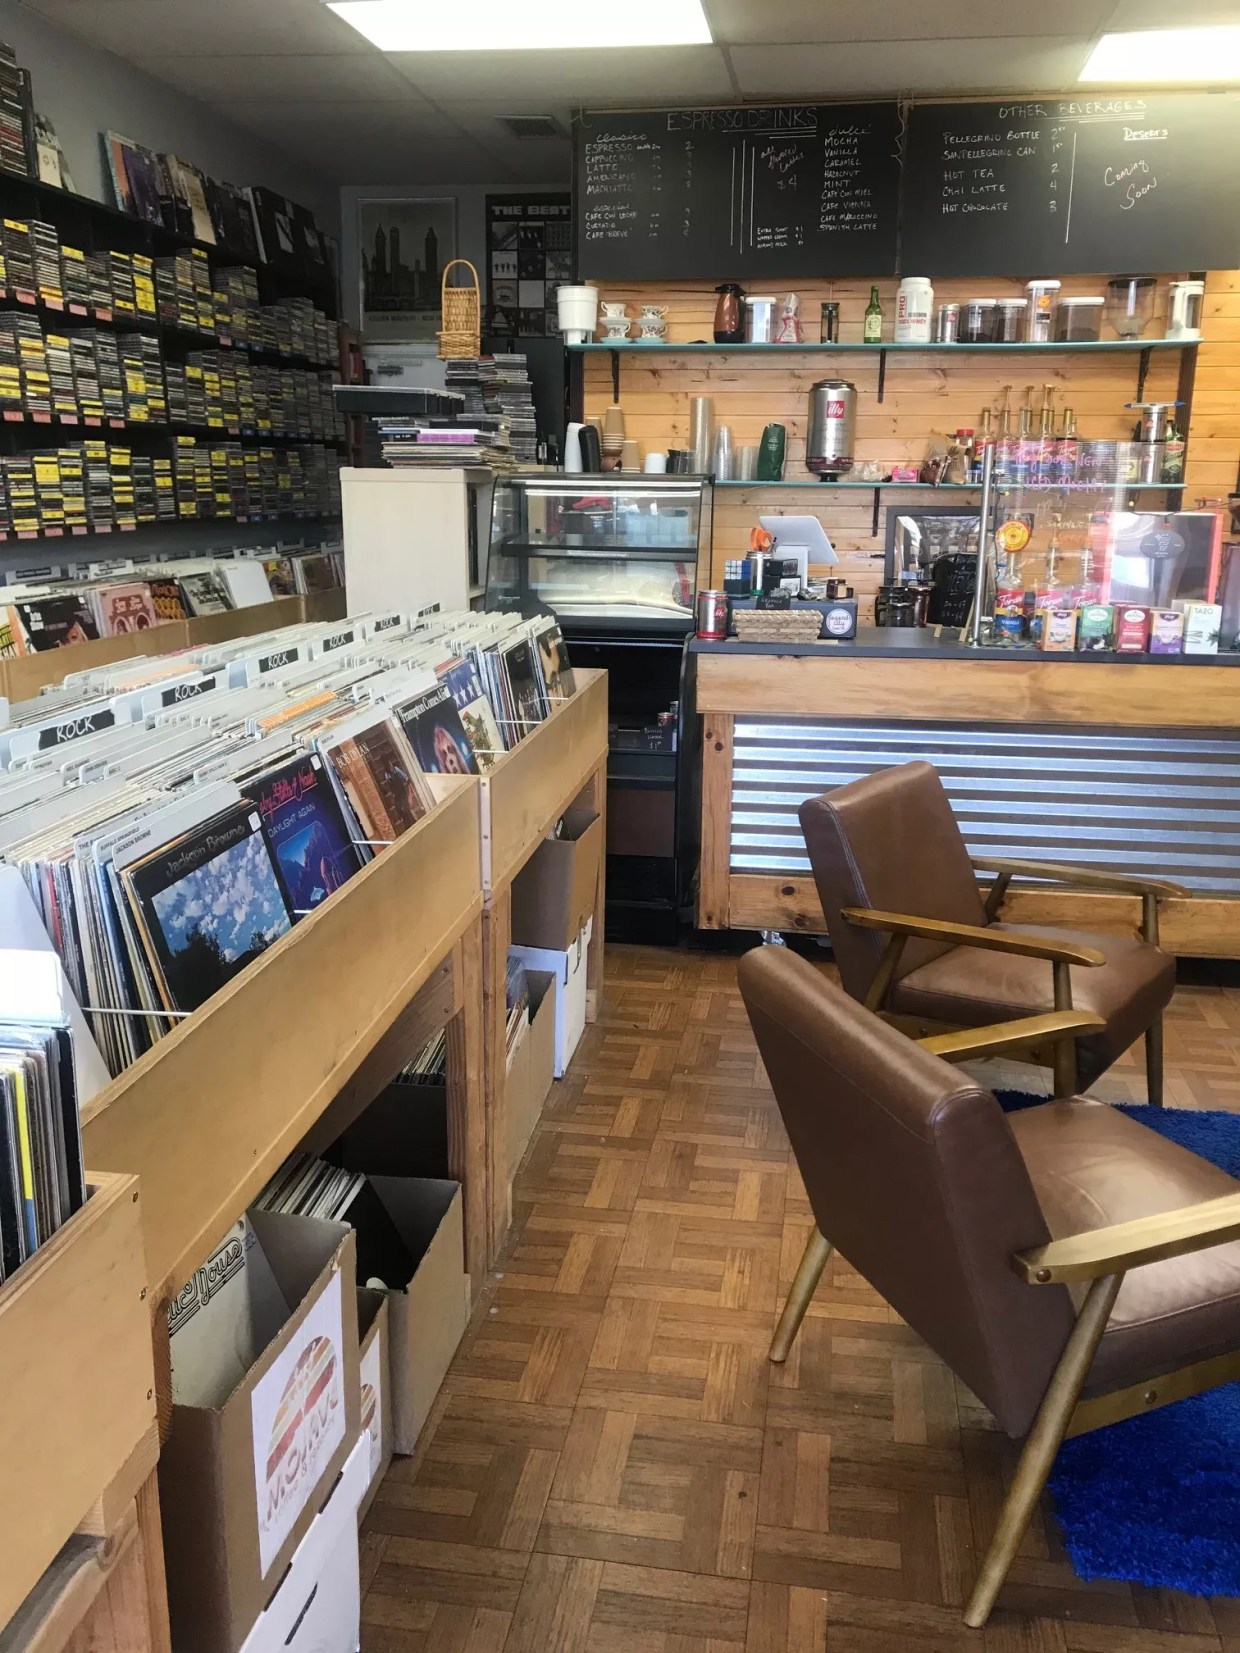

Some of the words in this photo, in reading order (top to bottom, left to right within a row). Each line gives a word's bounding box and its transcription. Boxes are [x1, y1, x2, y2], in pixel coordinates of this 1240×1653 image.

[999, 104, 1047, 119] OTHER
[1059, 100, 1147, 115] BEVERAGES
[667, 110, 743, 130] ESPRESSO
[747, 107, 817, 128] DRINKS
[824, 136, 858, 147] MOCHA
[942, 131, 1001, 144] PELLEGRINO
[1006, 130, 1040, 141] BOTTLE
[585, 143, 633, 154] ESPRESSO
[824, 147, 858, 158] VANILLA
[1016, 146, 1037, 157] CAN
[586, 164, 618, 174] LATTE
[824, 158, 862, 168] CARAMEL
[943, 170, 965, 181] HOT
[972, 168, 994, 179] TEA
[1051, 162, 1060, 173] 2
[1104, 160, 1150, 186] Coming
[824, 179, 851, 189] MINT
[942, 186, 964, 197] CHAI
[971, 183, 1006, 194] LATTE
[1049, 179, 1057, 191] 4
[1119, 177, 1157, 210] Soon
[491, 205, 523, 215] THE
[942, 203, 958, 214] HOT
[961, 201, 1009, 213] CHOCOLATE
[1049, 200, 1057, 212] 3
[853, 223, 877, 231] LATTE
[898, 295, 906, 318] PRO
[827, 402, 844, 415] illy
[1195, 607, 1214, 615] TAZO
[329, 634, 346, 649] ROCK
[267, 652, 288, 670] ROCK
[174, 684, 203, 702] ROCK
[56, 715, 95, 743] ROCK
[335, 753, 350, 769] BOB
[267, 813, 297, 838] DAYLIGHT
[297, 803, 316, 819] AGAIN
[78, 841, 90, 850] THE
[115, 839, 135, 854] JACKSON
[166, 846, 206, 877] Jackson
[205, 825, 245, 852] Browne
